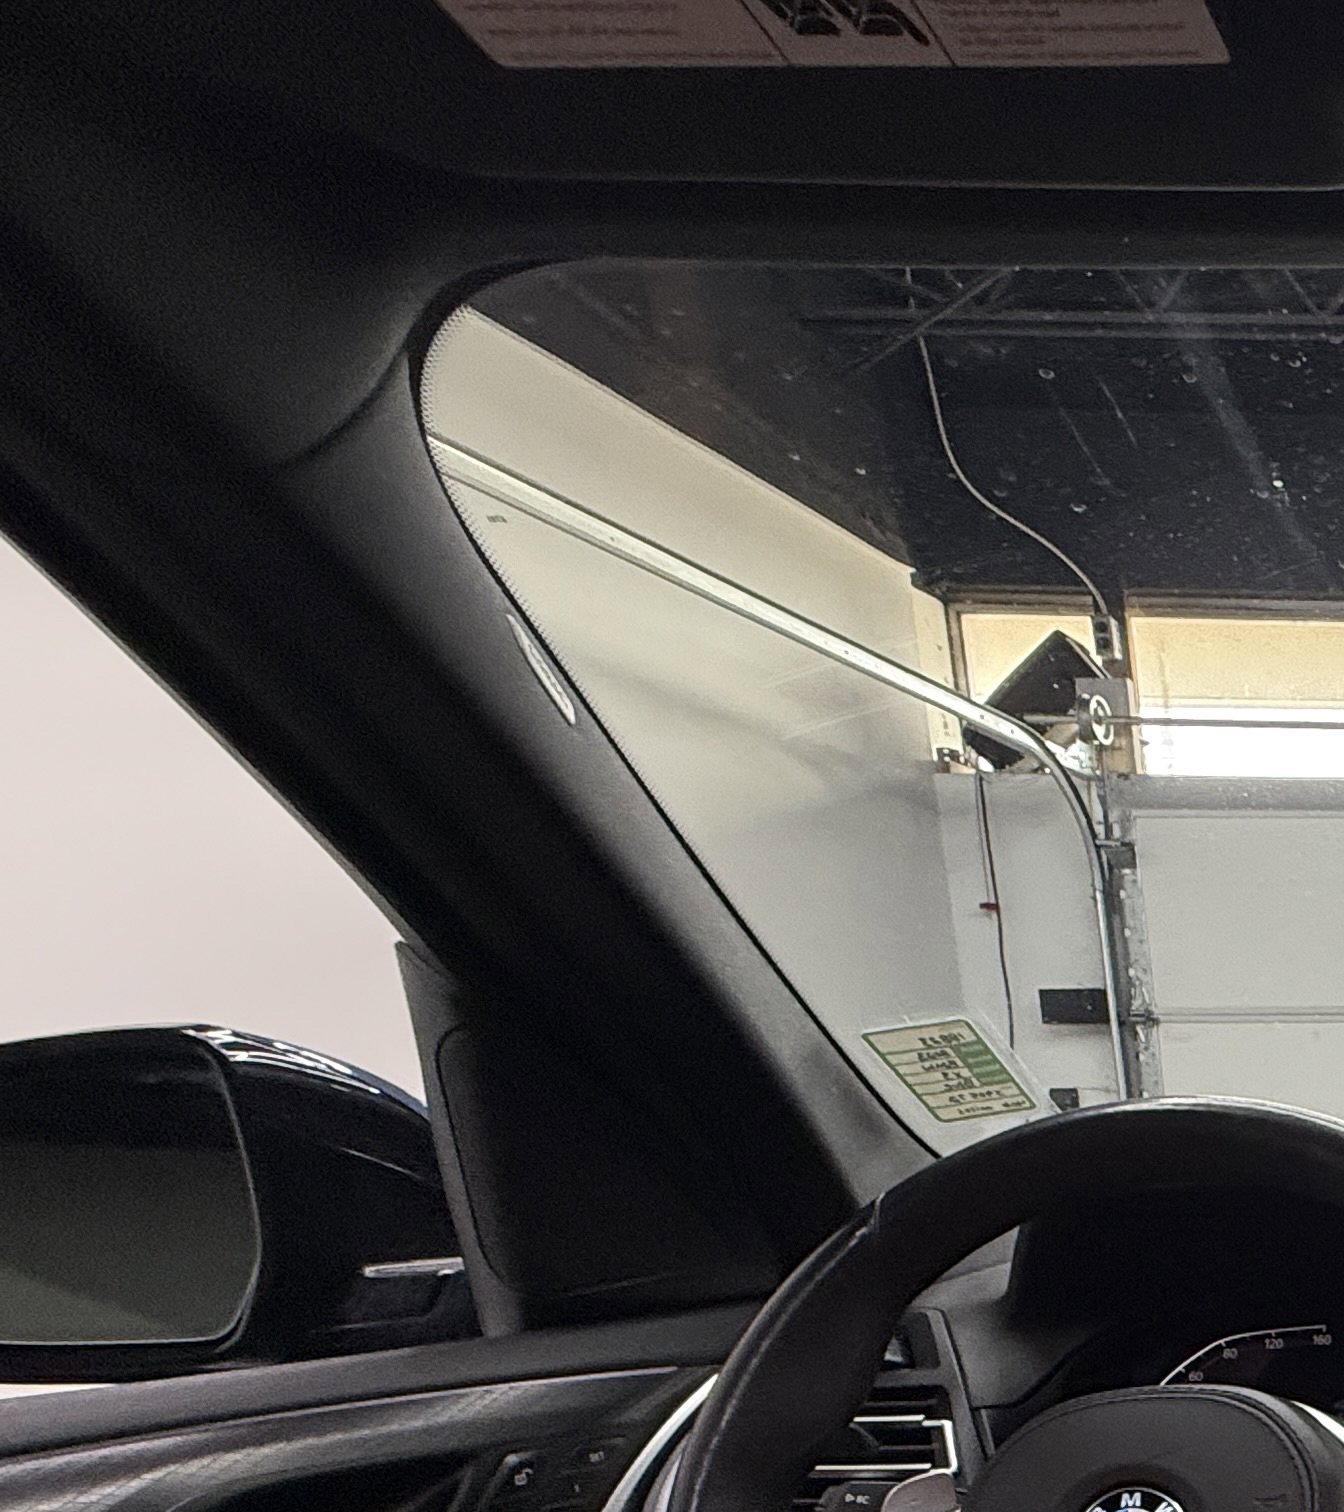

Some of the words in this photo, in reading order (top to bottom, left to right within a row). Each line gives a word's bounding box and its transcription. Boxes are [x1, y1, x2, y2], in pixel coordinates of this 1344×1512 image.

[1264, 1338, 1284, 1350] 120
[1312, 1334, 1332, 1346] 160
[1222, 1348, 1238, 1360] 80
[1188, 1371, 1203, 1382] 60
